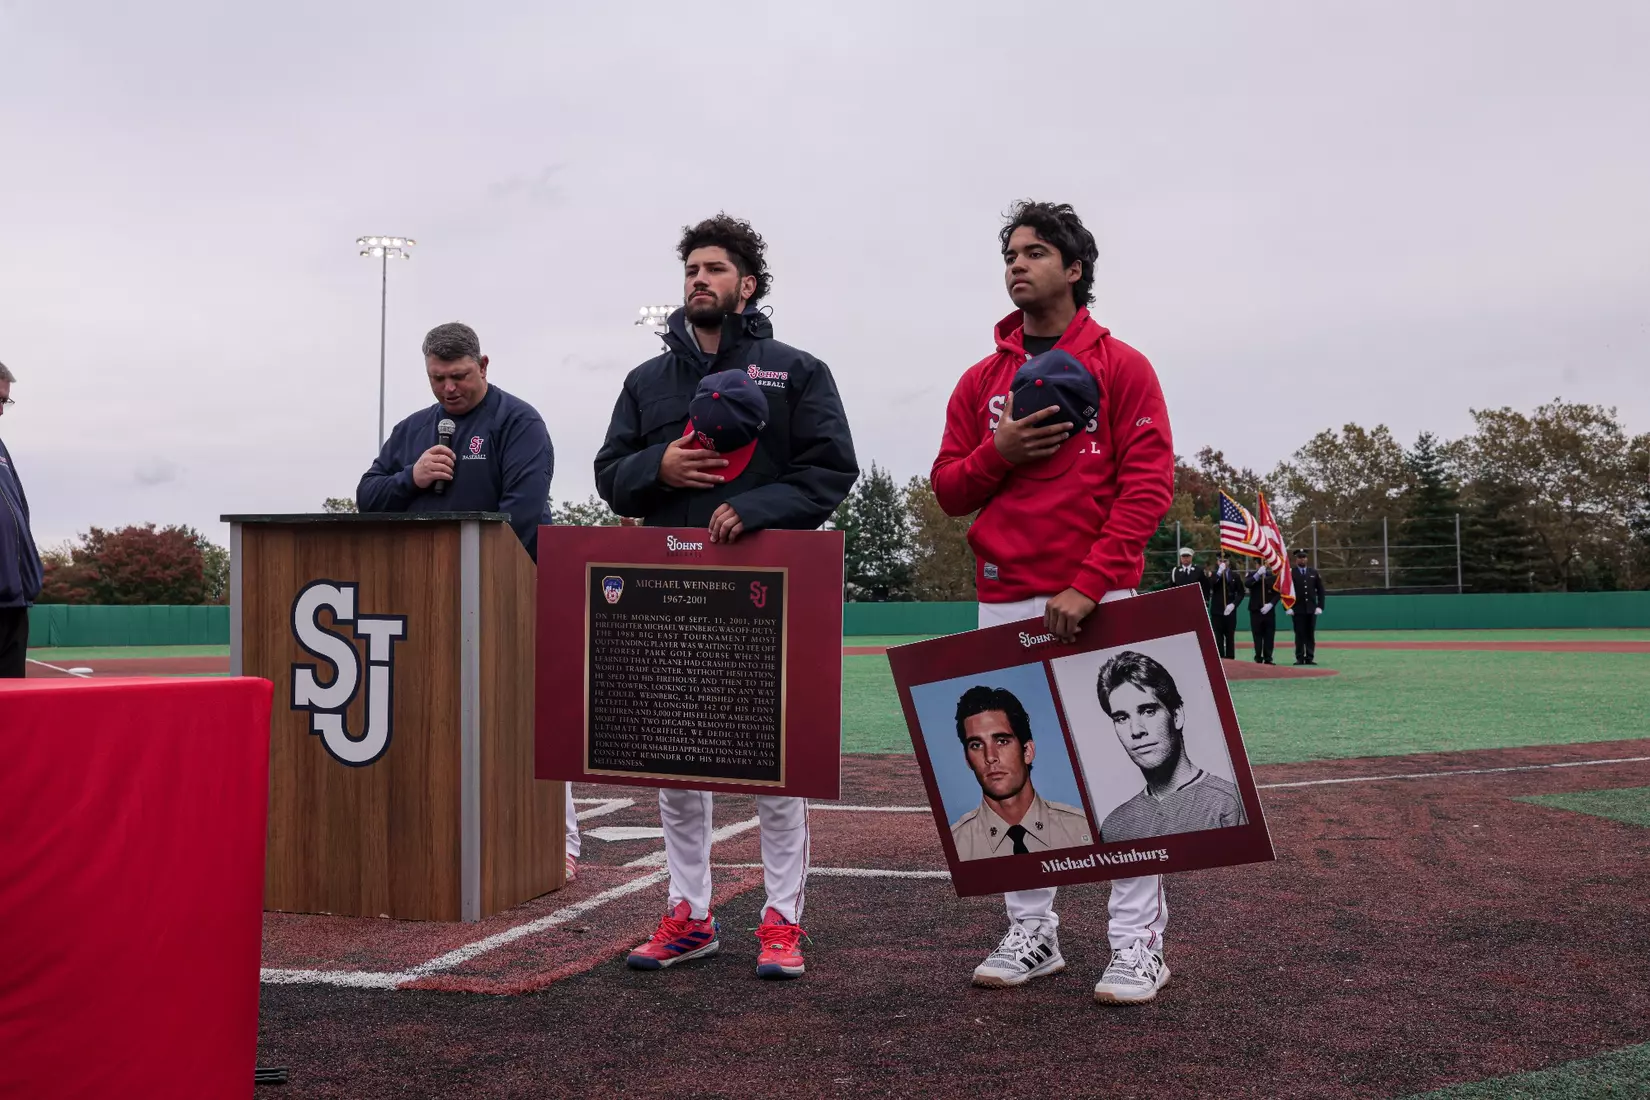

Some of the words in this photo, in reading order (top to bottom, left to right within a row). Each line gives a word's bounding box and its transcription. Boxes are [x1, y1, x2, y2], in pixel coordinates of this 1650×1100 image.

[635, 579, 680, 589] MICHAEL
[682, 580, 736, 590] WEINBERG
[662, 594, 707, 604] 1967-2001
[594, 638, 649, 646] OUTSTANDING
[682, 633, 746, 642] TOURNAMENT
[701, 659, 736, 668] CRASHED
[686, 668, 724, 676] WITHOUT
[656, 675, 697, 683] FIREHOUSE
[651, 683, 686, 691] LOOKING
[697, 694, 733, 702] PERISHED
[652, 700, 699, 709] ALONGSIDE
[696, 711, 726, 719] FELLOW
[661, 718, 695, 726] DECADES
[697, 720, 735, 729] REMOVED
[594, 723, 636, 732] ULTIMATE
[707, 729, 750, 738] DEDICATE
[594, 731, 639, 740] MONUMENT
[648, 743, 678, 751] SHARED
[679, 745, 733, 755] APPRECIATION
[734, 748, 758, 756] SERVE
[594, 748, 636, 757] CONSTANT
[640, 751, 681, 760] REMINDER
[715, 756, 752, 764] BRAVERY
[1040, 854, 1096, 873] Michael
[1096, 848, 1169, 866] Weinburg
